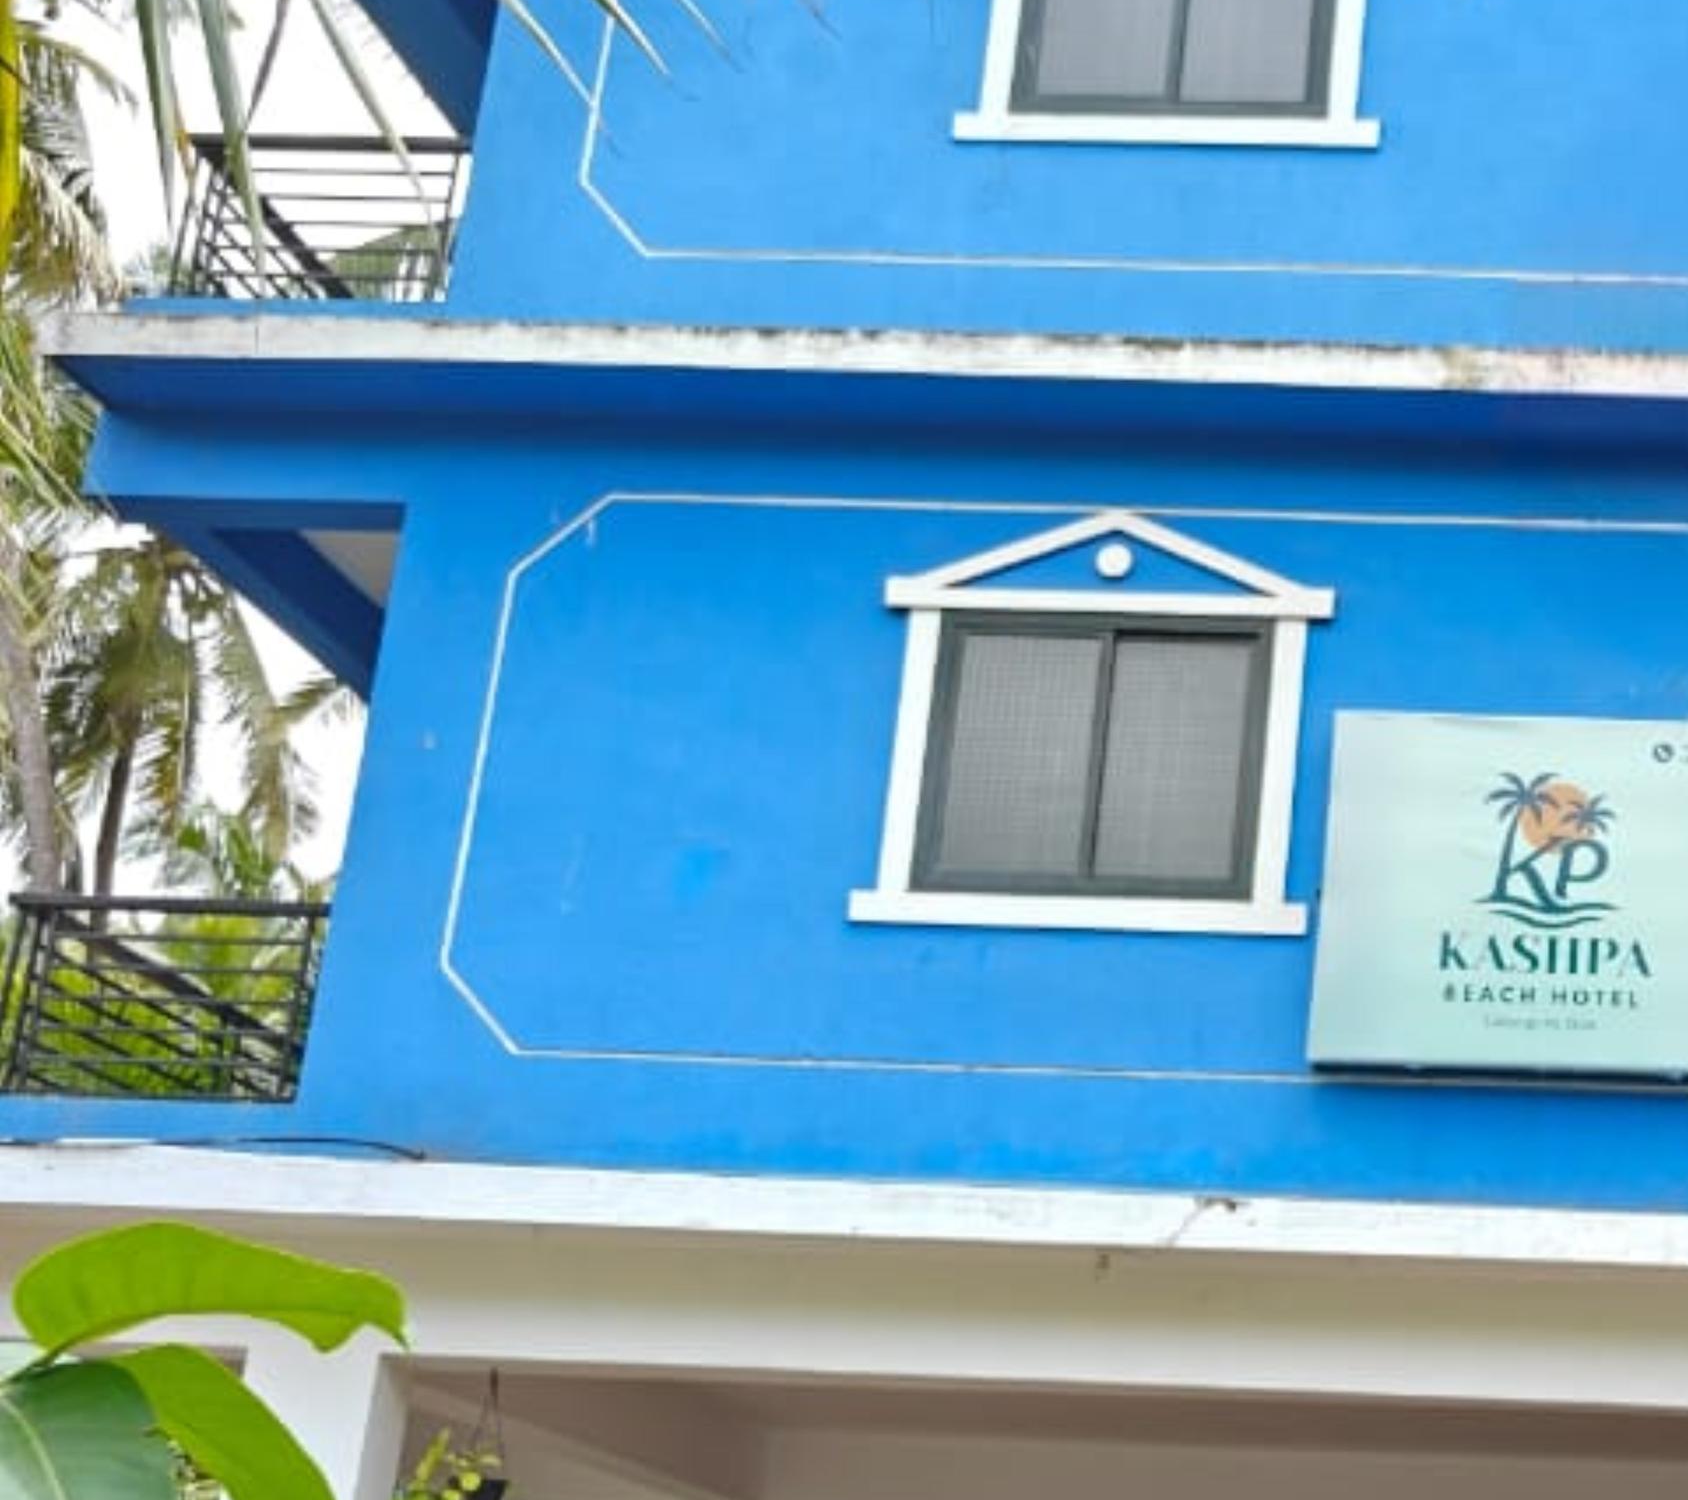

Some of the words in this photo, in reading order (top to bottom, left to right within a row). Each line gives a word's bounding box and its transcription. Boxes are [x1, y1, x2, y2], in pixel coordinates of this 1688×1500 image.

[1439, 931, 1653, 978] KASHPA
[1443, 983, 1537, 1002] BEACH
[1551, 986, 1638, 1008] HOTEL
